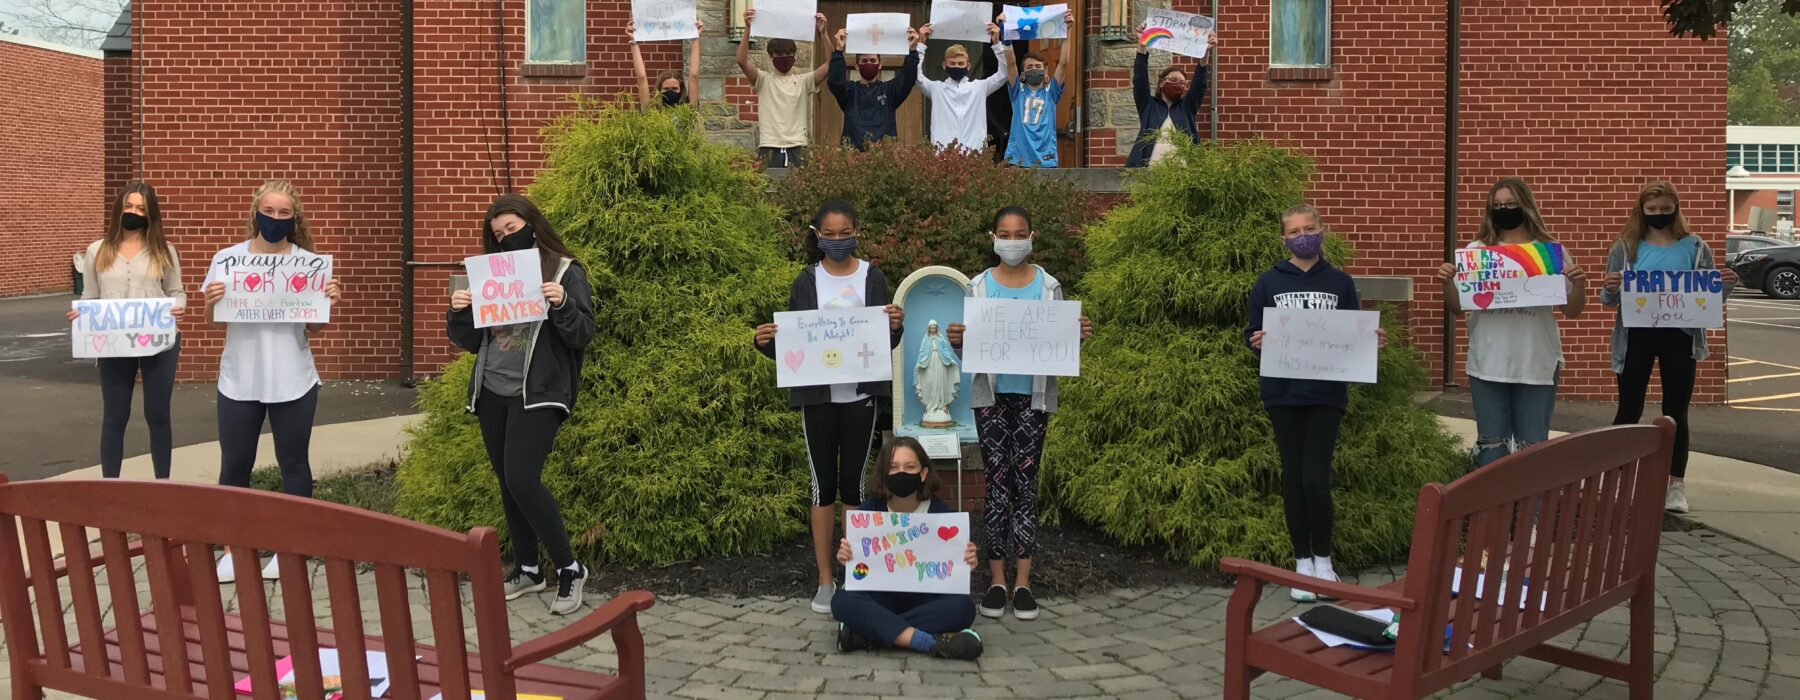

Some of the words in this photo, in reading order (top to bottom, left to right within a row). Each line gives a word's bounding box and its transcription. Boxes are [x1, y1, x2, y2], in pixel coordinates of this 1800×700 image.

[1152, 15, 1187, 30] STORM
[1023, 97, 1045, 124] 17
[217, 254, 329, 278] praying
[488, 254, 516, 277] IN
[1457, 263, 1465, 272] A
[232, 272, 275, 293] FOR
[281, 271, 325, 294] YOU
[482, 279, 525, 300] OUR
[1461, 281, 1501, 293] STORM
[1624, 270, 1722, 293] PRAYING
[225, 298, 249, 308] THERE
[255, 298, 263, 307] IS
[1275, 293, 1310, 302] NITTANY
[1313, 293, 1338, 302] LIONS
[1658, 293, 1685, 309] FOR
[77, 301, 175, 332] PRAYING
[235, 309, 260, 320] AFTER
[262, 308, 286, 320] EVERY
[289, 308, 318, 319] STORM
[480, 299, 545, 324] PRAYERS
[981, 306, 1006, 322] WE
[1022, 305, 1058, 322] ARE
[1651, 312, 1684, 327] you
[797, 316, 838, 329] Everything
[995, 320, 1039, 340] HERE
[980, 342, 1010, 361] FOR
[1030, 341, 1075, 361] YOU!
[861, 522, 929, 557] PRAYING
[884, 548, 917, 573] FOR
[915, 560, 954, 582] YOU!
